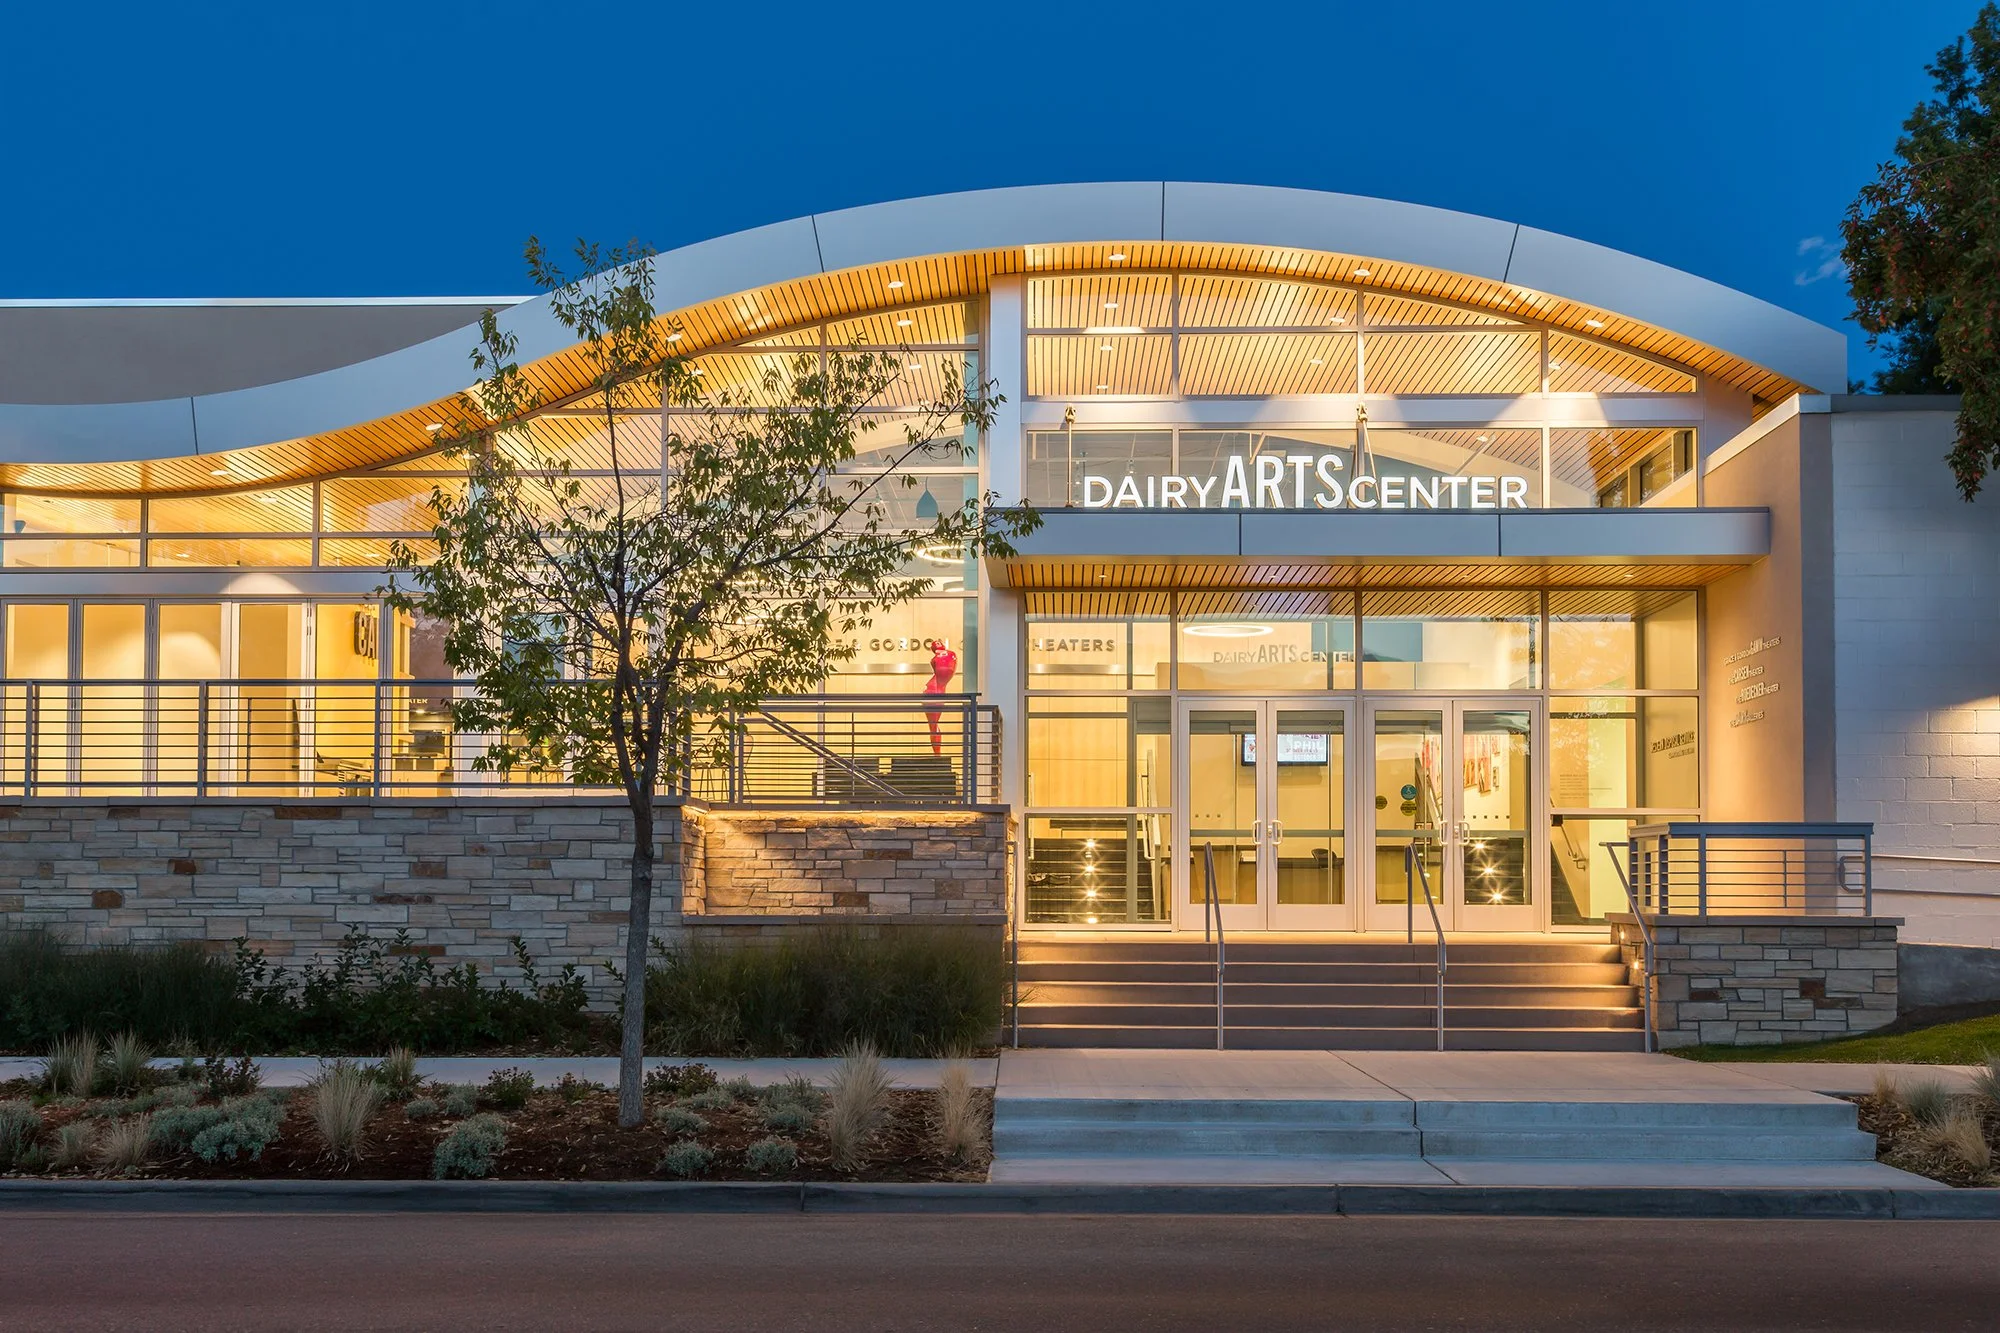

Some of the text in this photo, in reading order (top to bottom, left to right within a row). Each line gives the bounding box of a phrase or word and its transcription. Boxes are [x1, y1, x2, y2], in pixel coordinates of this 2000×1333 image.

[1083, 454, 1529, 509] DAIRY ARTS CENTER
[354, 611, 378, 659] CA
[1031, 638, 1115, 652] HEATERS
[1213, 651, 1257, 663] DAIRY
[1257, 644, 1298, 663] ARTS
